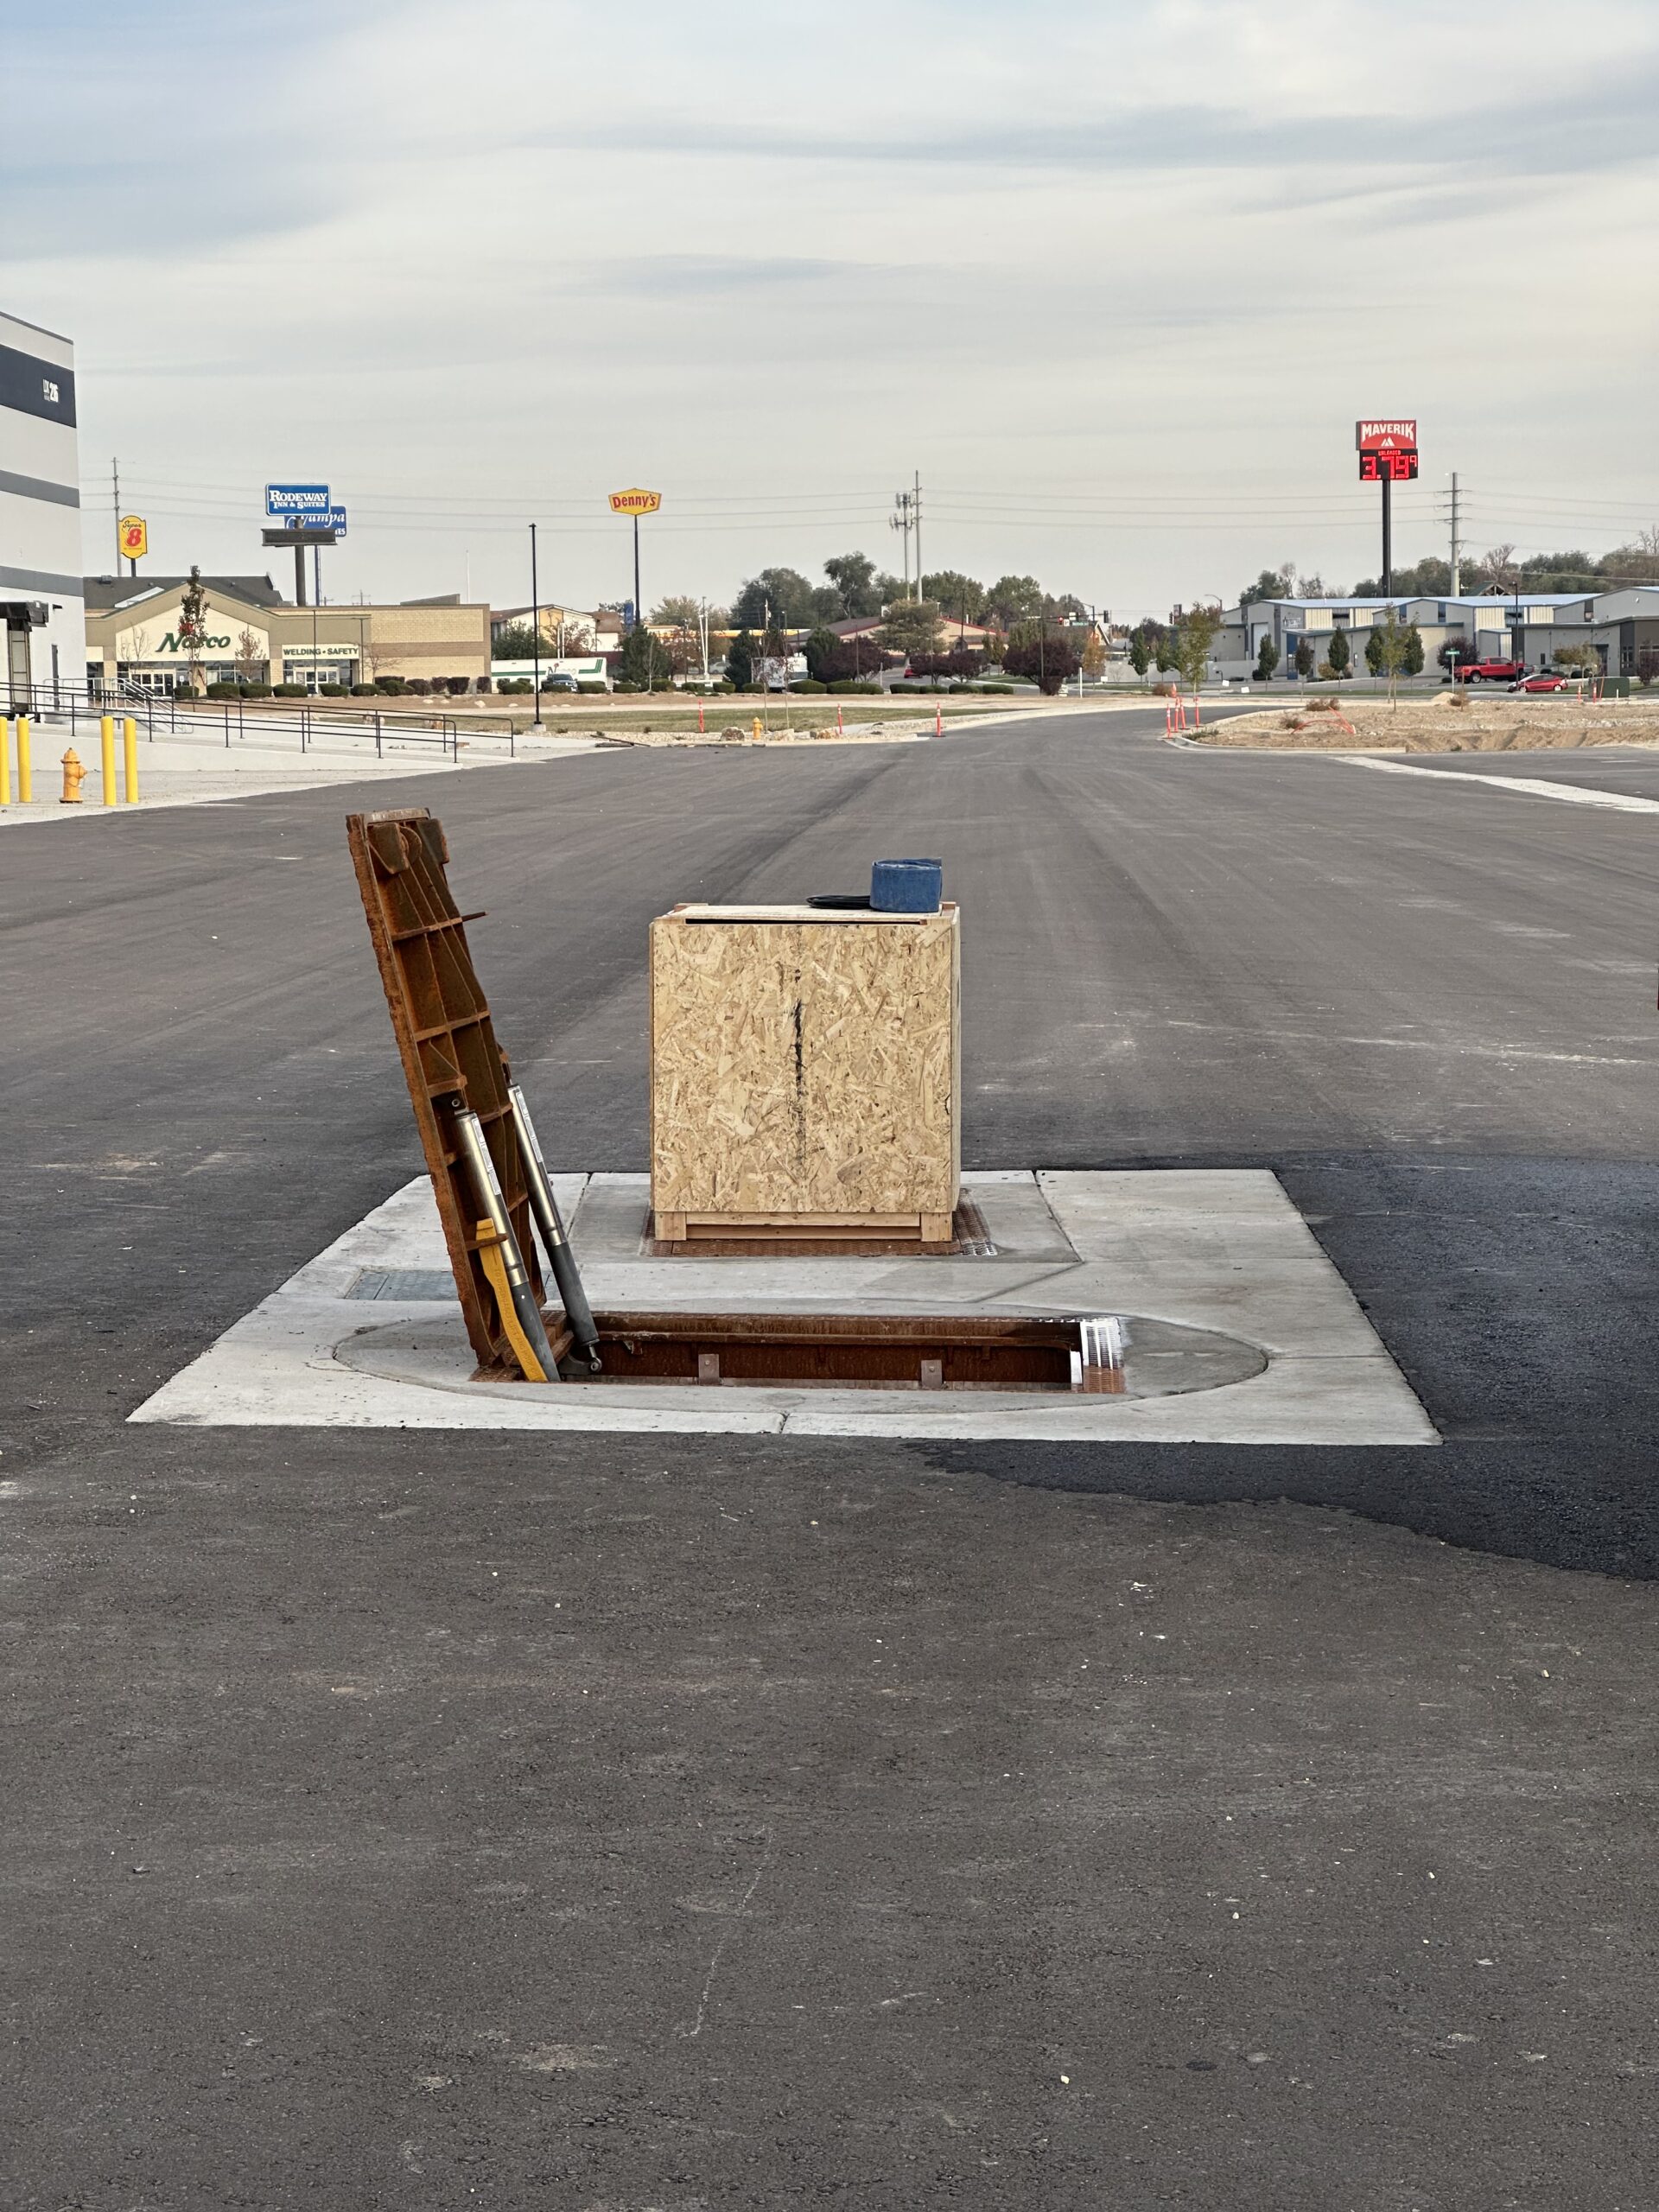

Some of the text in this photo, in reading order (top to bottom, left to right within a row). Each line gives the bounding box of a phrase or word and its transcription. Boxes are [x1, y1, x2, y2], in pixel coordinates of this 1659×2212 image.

[1362, 423, 1414, 442] MAVERIK
[269, 490, 327, 502] RODEWAY
[612, 493, 657, 509] Denny's
[121, 519, 143, 533] Super
[126, 527, 143, 547] 8
